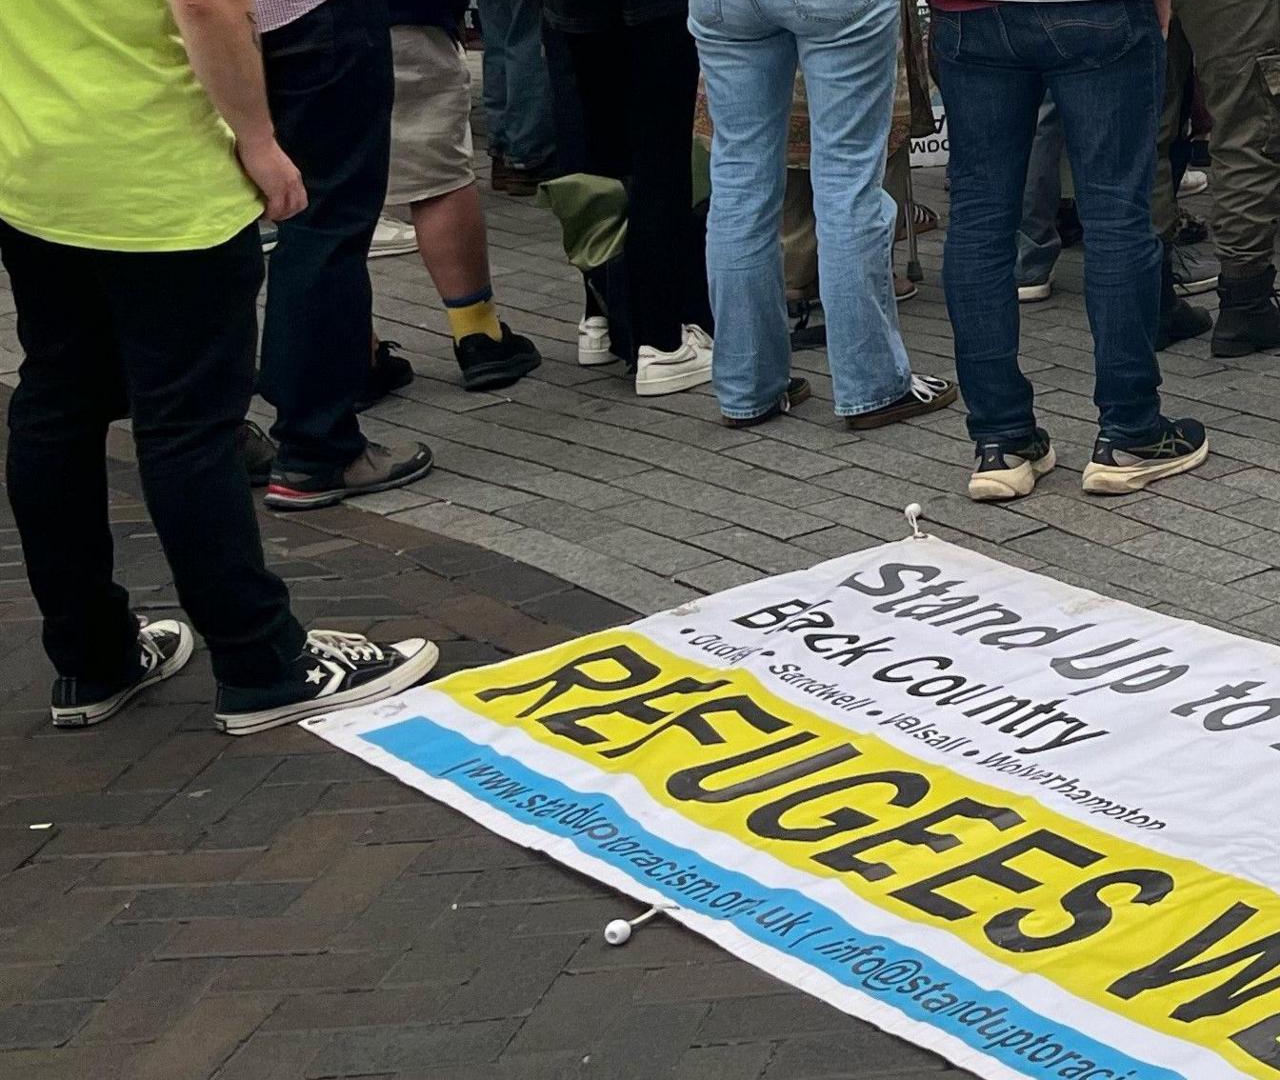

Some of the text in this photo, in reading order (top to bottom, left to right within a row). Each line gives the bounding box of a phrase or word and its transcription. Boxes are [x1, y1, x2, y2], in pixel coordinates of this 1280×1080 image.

[838, 563, 1096, 649] Stand
[1050, 638, 1190, 696] Up
[872, 656, 1111, 754] Country
[474, 644, 1174, 953] REFUGEES
[768, 663, 877, 714] Sandwell
[977, 751, 1167, 832] Wolverhampton
